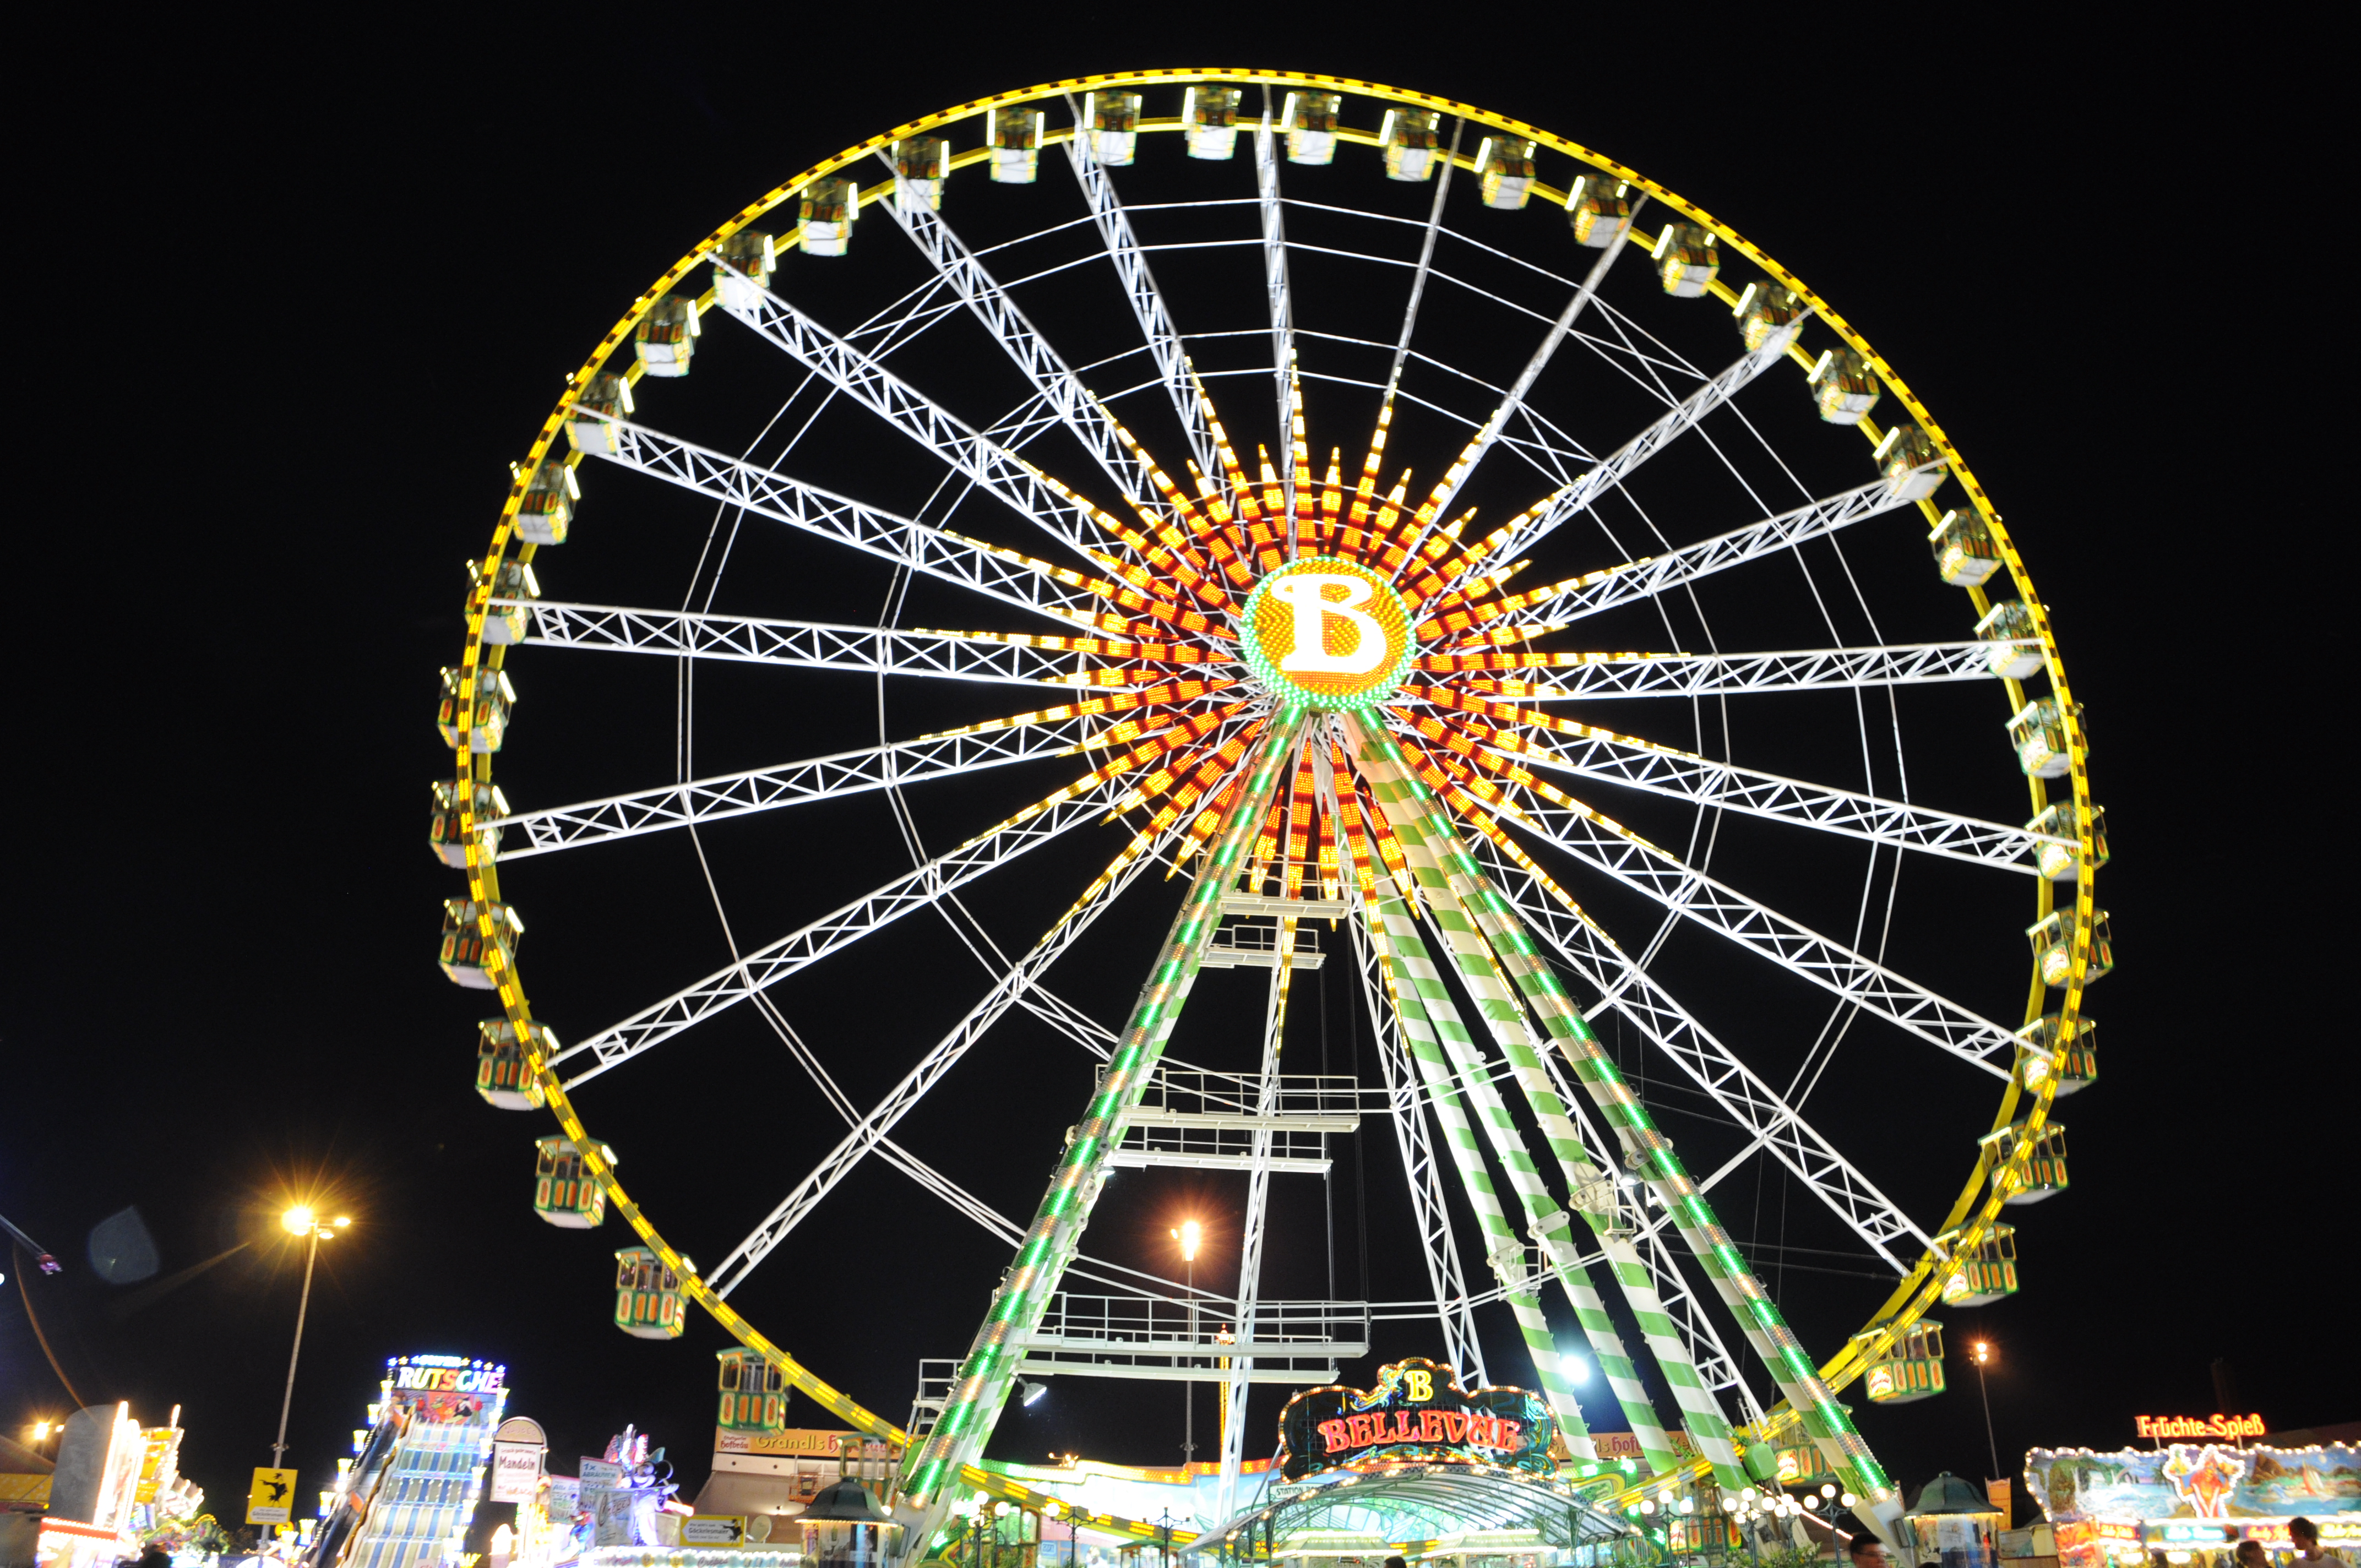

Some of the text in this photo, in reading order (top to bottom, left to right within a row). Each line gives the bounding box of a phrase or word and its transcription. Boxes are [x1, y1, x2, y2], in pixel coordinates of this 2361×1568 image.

[1271, 574, 1387, 674] B
[396, 1366, 505, 1393] RUTSCHE
[1404, 1369, 1433, 1401] B
[755, 1434, 825, 1450] Grandls
[1318, 1410, 1520, 1453] BELLEVUE
[498, 1456, 535, 1471] Mandeln
[1276, 1486, 1303, 1495] STATION
